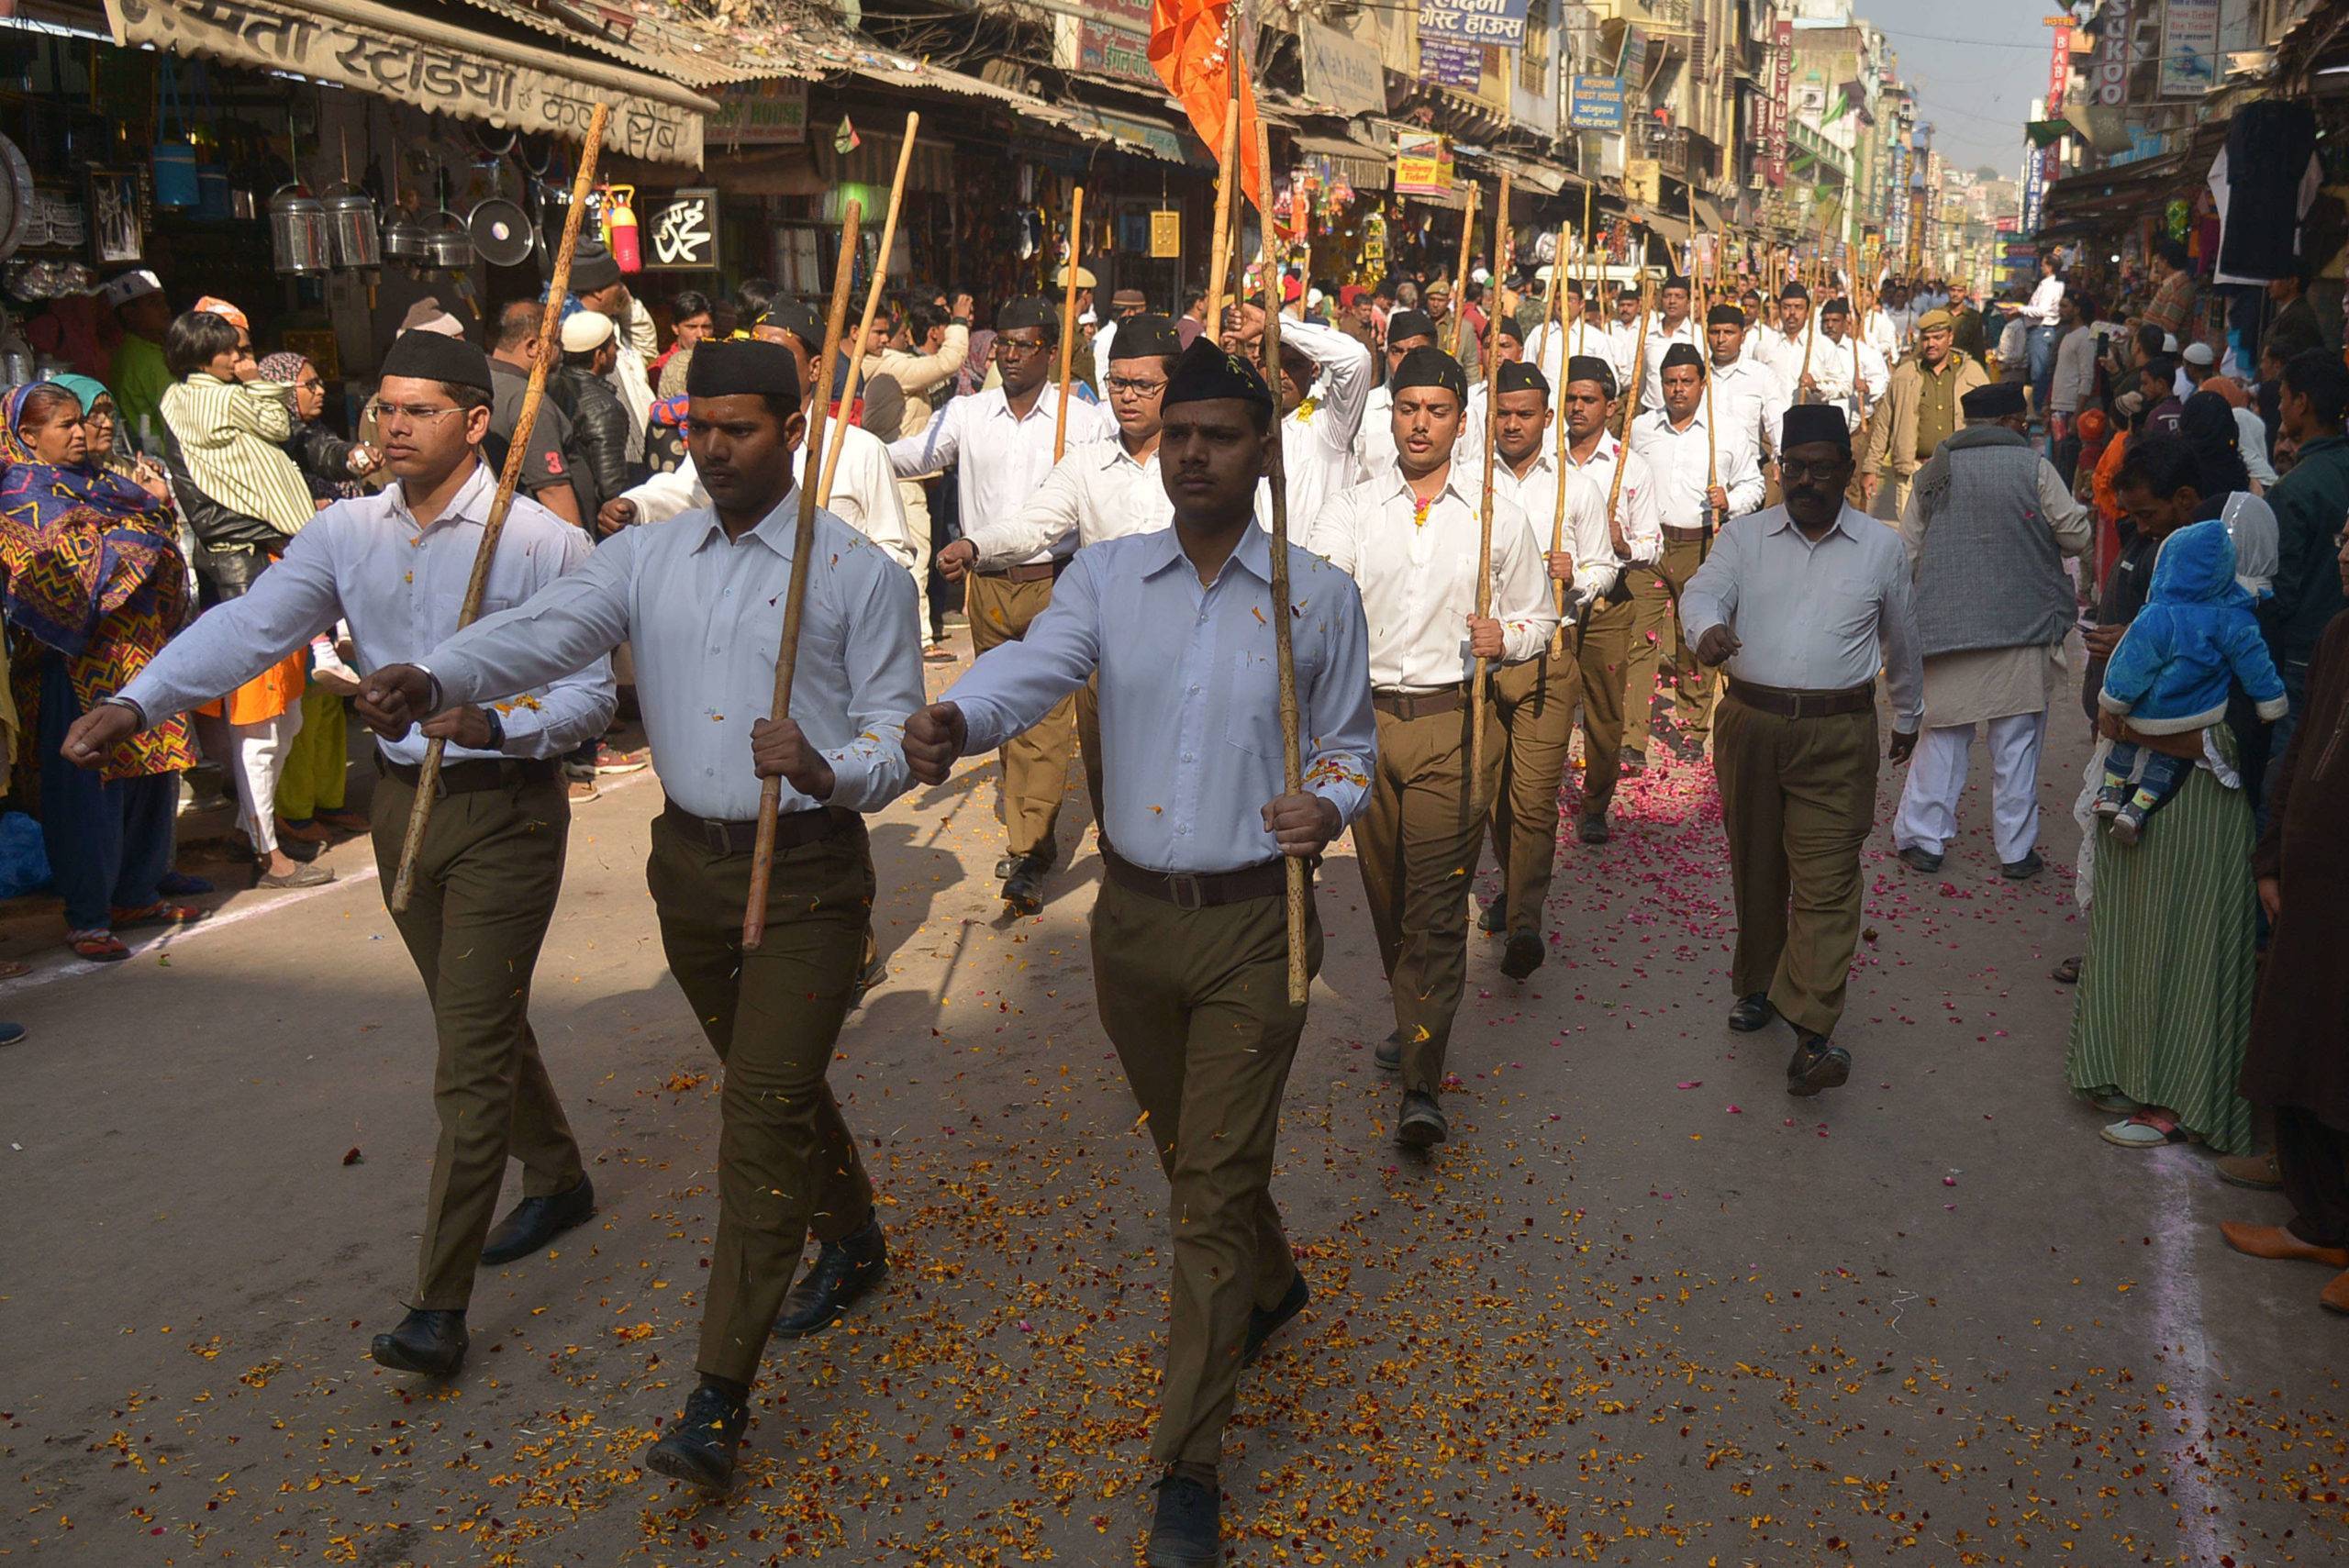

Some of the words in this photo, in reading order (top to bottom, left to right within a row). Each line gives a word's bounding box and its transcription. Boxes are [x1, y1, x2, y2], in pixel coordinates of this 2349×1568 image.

[2043, 17, 2076, 27] HOTEL
[2054, 37, 2065, 92] BABA
[1773, 35, 1790, 173] RESTAURANT
[1401, 162, 1433, 174] Railway
[1405, 172, 1430, 182] Ticket
[545, 451, 563, 474] 3
